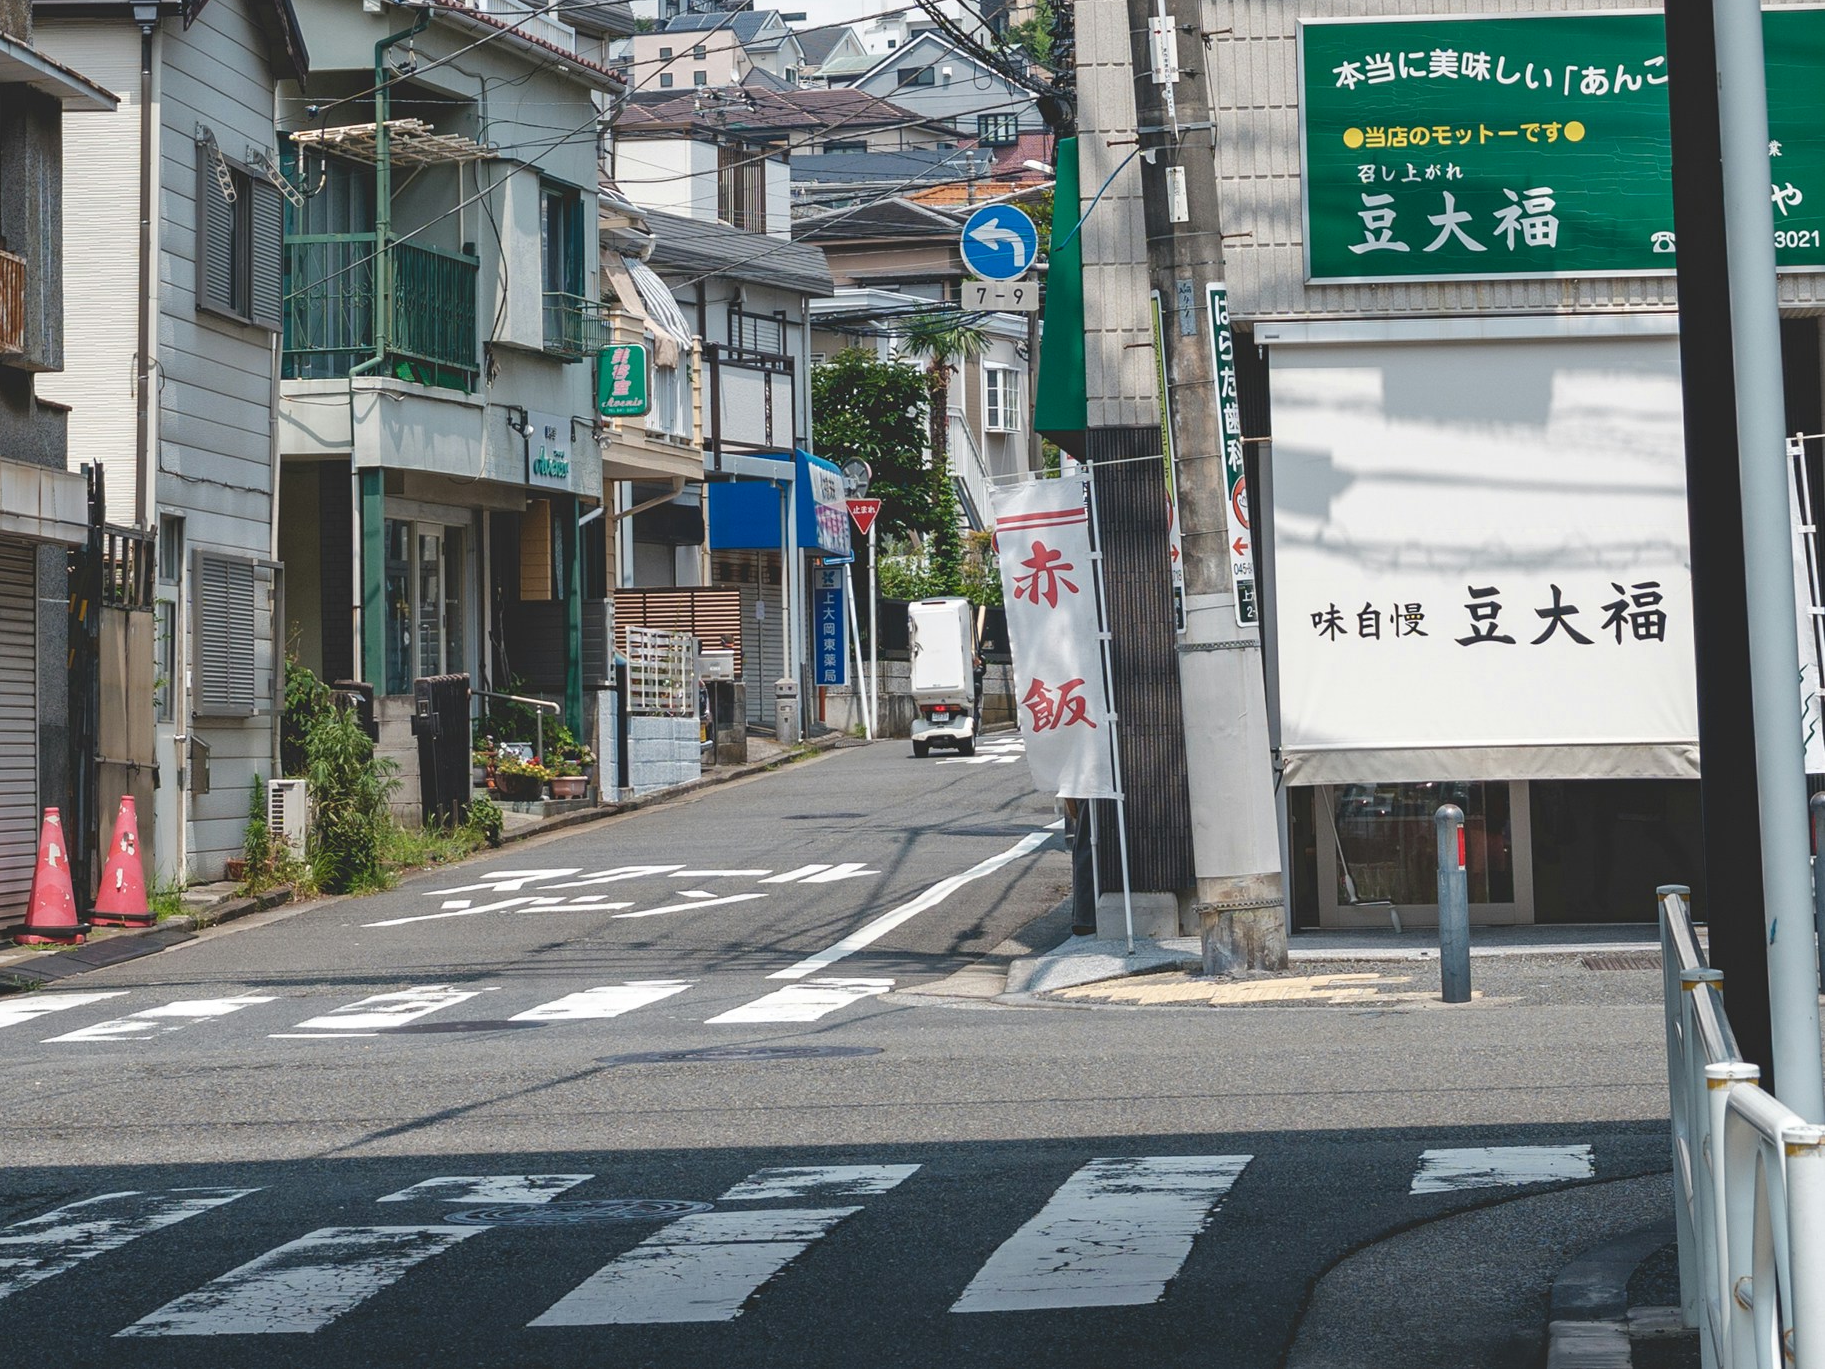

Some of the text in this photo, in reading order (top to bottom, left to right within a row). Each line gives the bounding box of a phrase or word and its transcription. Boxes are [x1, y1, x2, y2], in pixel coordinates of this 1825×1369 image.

[1365, 121, 1563, 148] 当店のモットーです
[1357, 161, 1464, 183] 召し上がれ
[1348, 186, 1560, 255] 豆大福
[853, 505, 876, 515] 止まれ
[822, 592, 837, 683] 上大岡東薬局
[1012, 540, 1097, 733] 赤飯
[1310, 581, 1667, 647] 味自慢 豆大福
[422, 864, 882, 896] スクール
